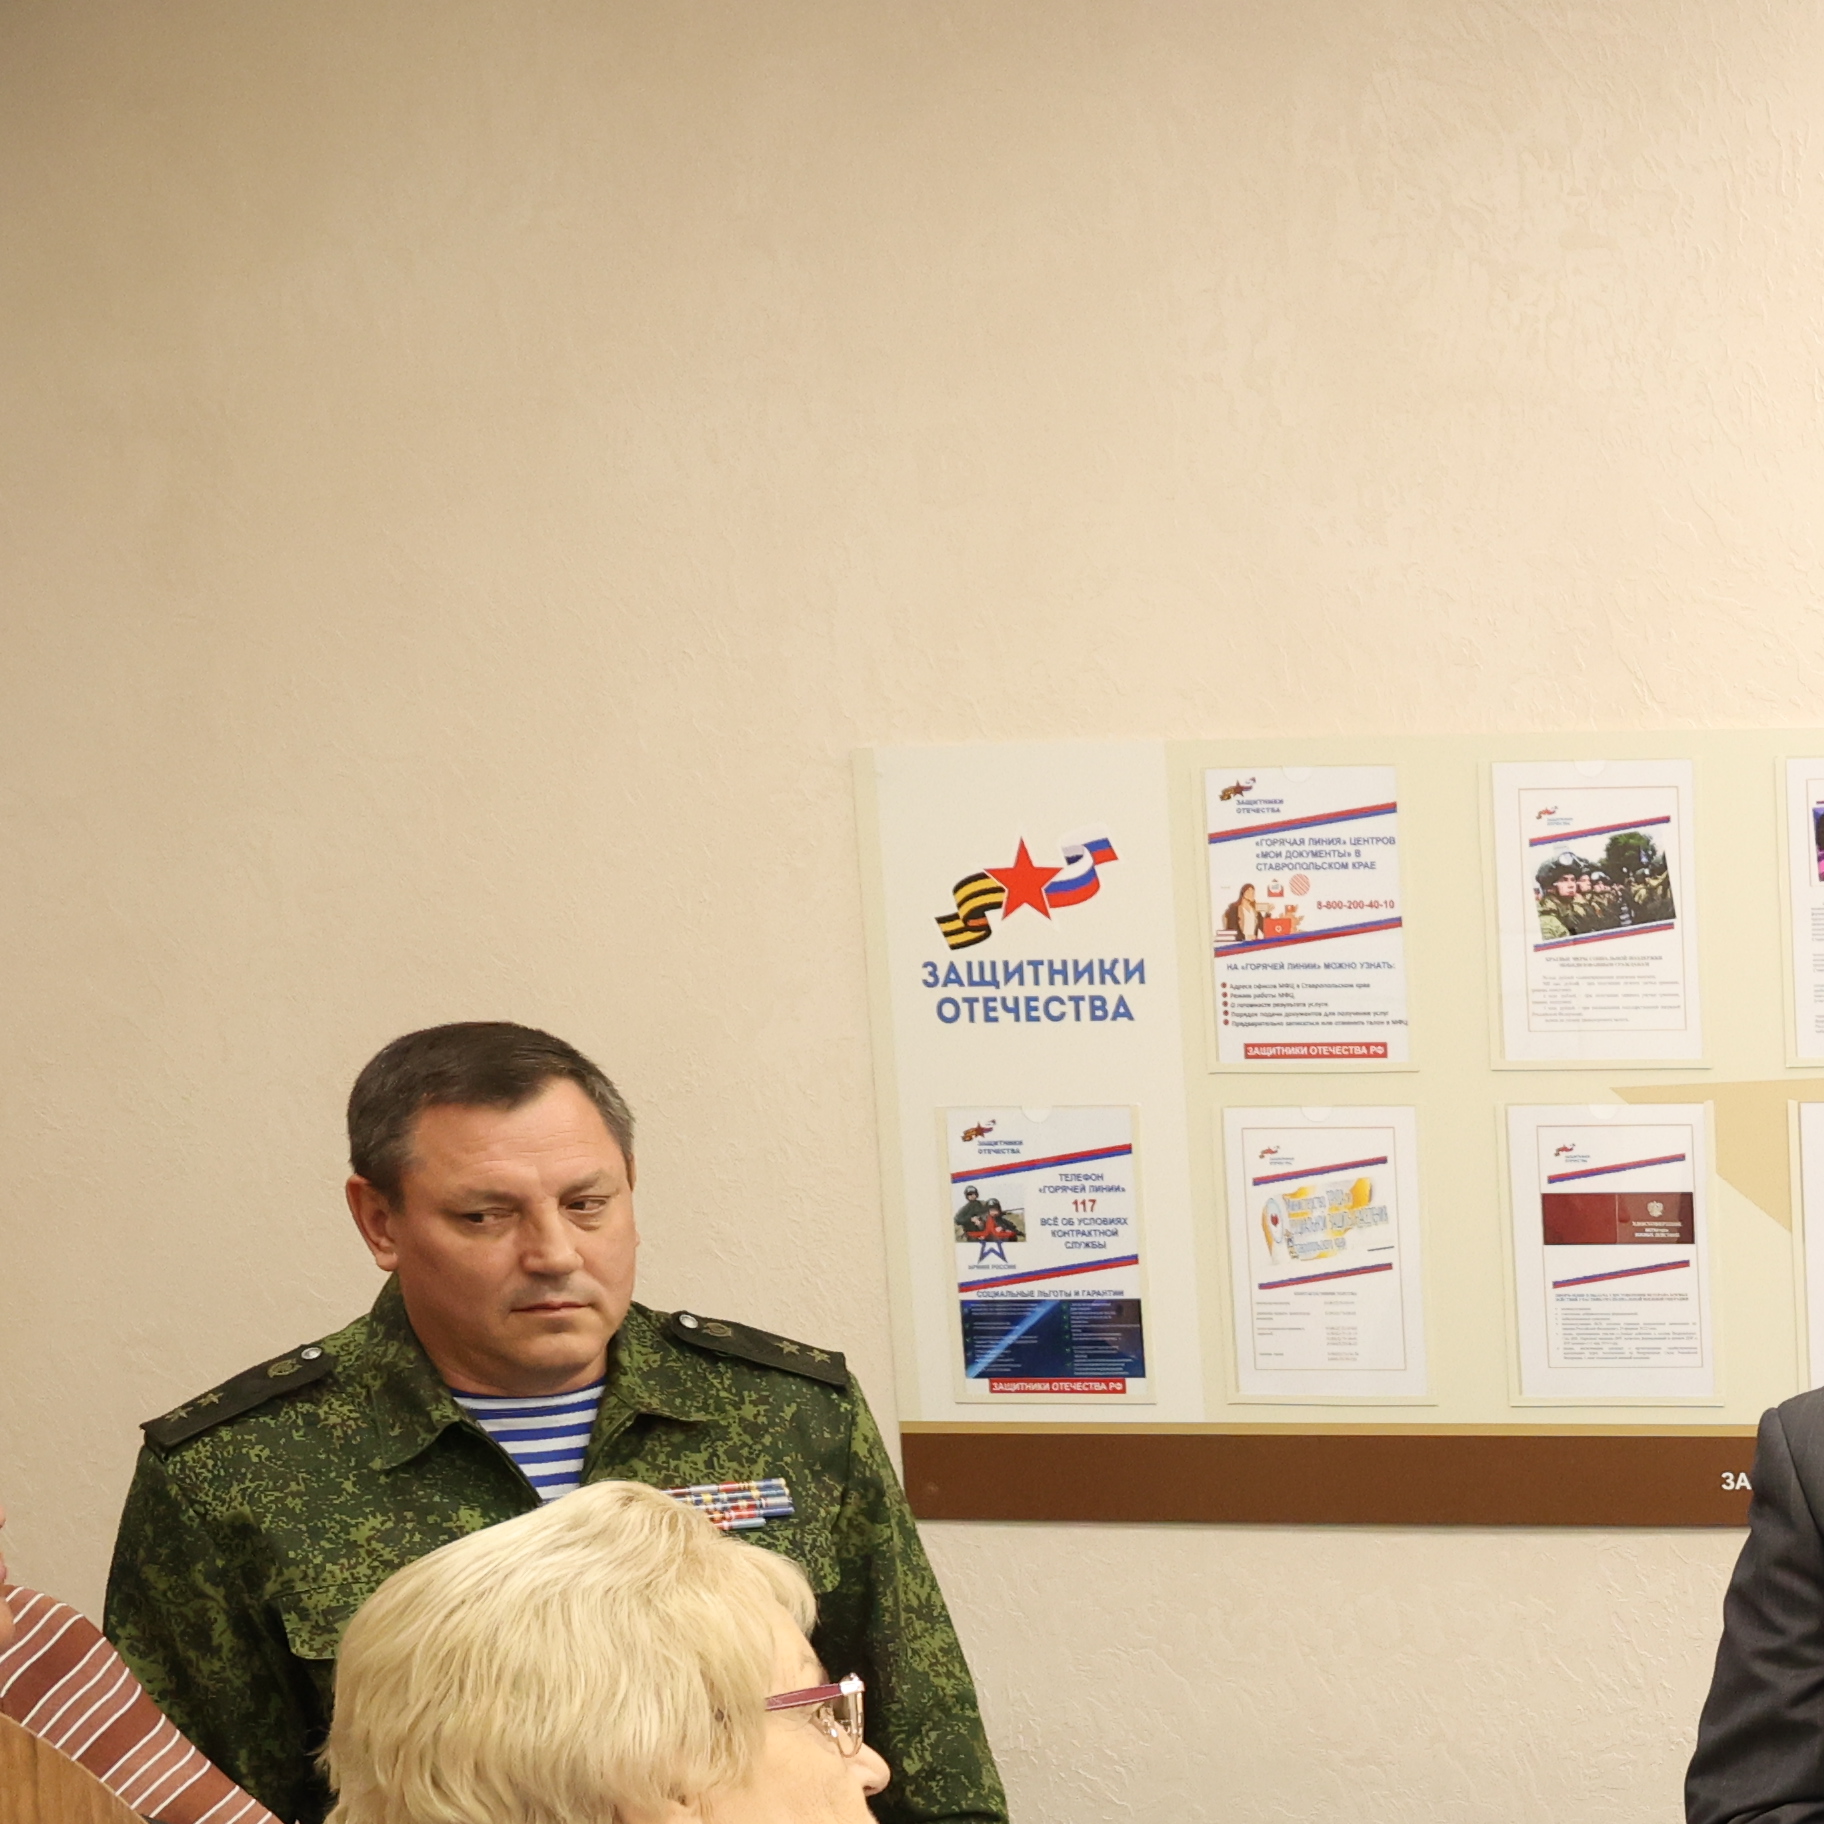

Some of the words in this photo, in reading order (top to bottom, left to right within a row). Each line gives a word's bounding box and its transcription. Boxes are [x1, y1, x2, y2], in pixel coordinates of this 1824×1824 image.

[1255, 838, 1305, 847] «ГОРЯЧАЯ
[1308, 838, 1346, 846] ЛИНИЯ»
[1349, 836, 1396, 846] ЦЕНТРОВ
[1285, 850, 1351, 860] ДОКУМЕНТЫ»
[1355, 849, 1361, 858] В
[1256, 862, 1349, 871] СТАВРОПОЛЬСКОМ
[1352, 861, 1376, 870] КРАЕ
[1317, 900, 1395, 909] 8-800-200-40-10
[1227, 963, 1238, 971] НА
[1241, 961, 1284, 971] «ГОРЯЧЕЙ
[1324, 962, 1356, 970] МОЖНО
[1360, 961, 1396, 969] УЗНАТЬ:
[922, 958, 1146, 989] ЗАЩИТНИКИ
[936, 994, 1135, 1024] ОТЕЧЕСТВА
[1247, 1046, 1307, 1057] ЗАЩИТНИКИ
[1309, 1046, 1367, 1055] ОТЕЧЕСТВА
[1370, 1046, 1384, 1054] РФ
[1059, 1173, 1104, 1182] ТЕЛЕФОН
[1039, 1184, 1086, 1193] «ГОРЯЧЕЙ
[1089, 1185, 1126, 1193] ЛИНИИ»
[1072, 1200, 1096, 1212] 117
[1040, 1217, 1059, 1226] ВСЁ
[1078, 1217, 1128, 1225] УСЛОВИЯХ
[1051, 1228, 1118, 1237] КОНТРАКТНОЙ
[1065, 1241, 1107, 1249] СЛУЖБЫ
[977, 1291, 1035, 1299] СОЦИАЛЬНЫЕ
[1037, 1290, 1072, 1298] ЛЬГОТЫ
[992, 1382, 1050, 1391] ЗАЩИТНИКИ
[1052, 1381, 1107, 1391] ОТЕЧЕСТВА
[1109, 1381, 1123, 1390] РФ
[1721, 1472, 1753, 1490] ЗА
